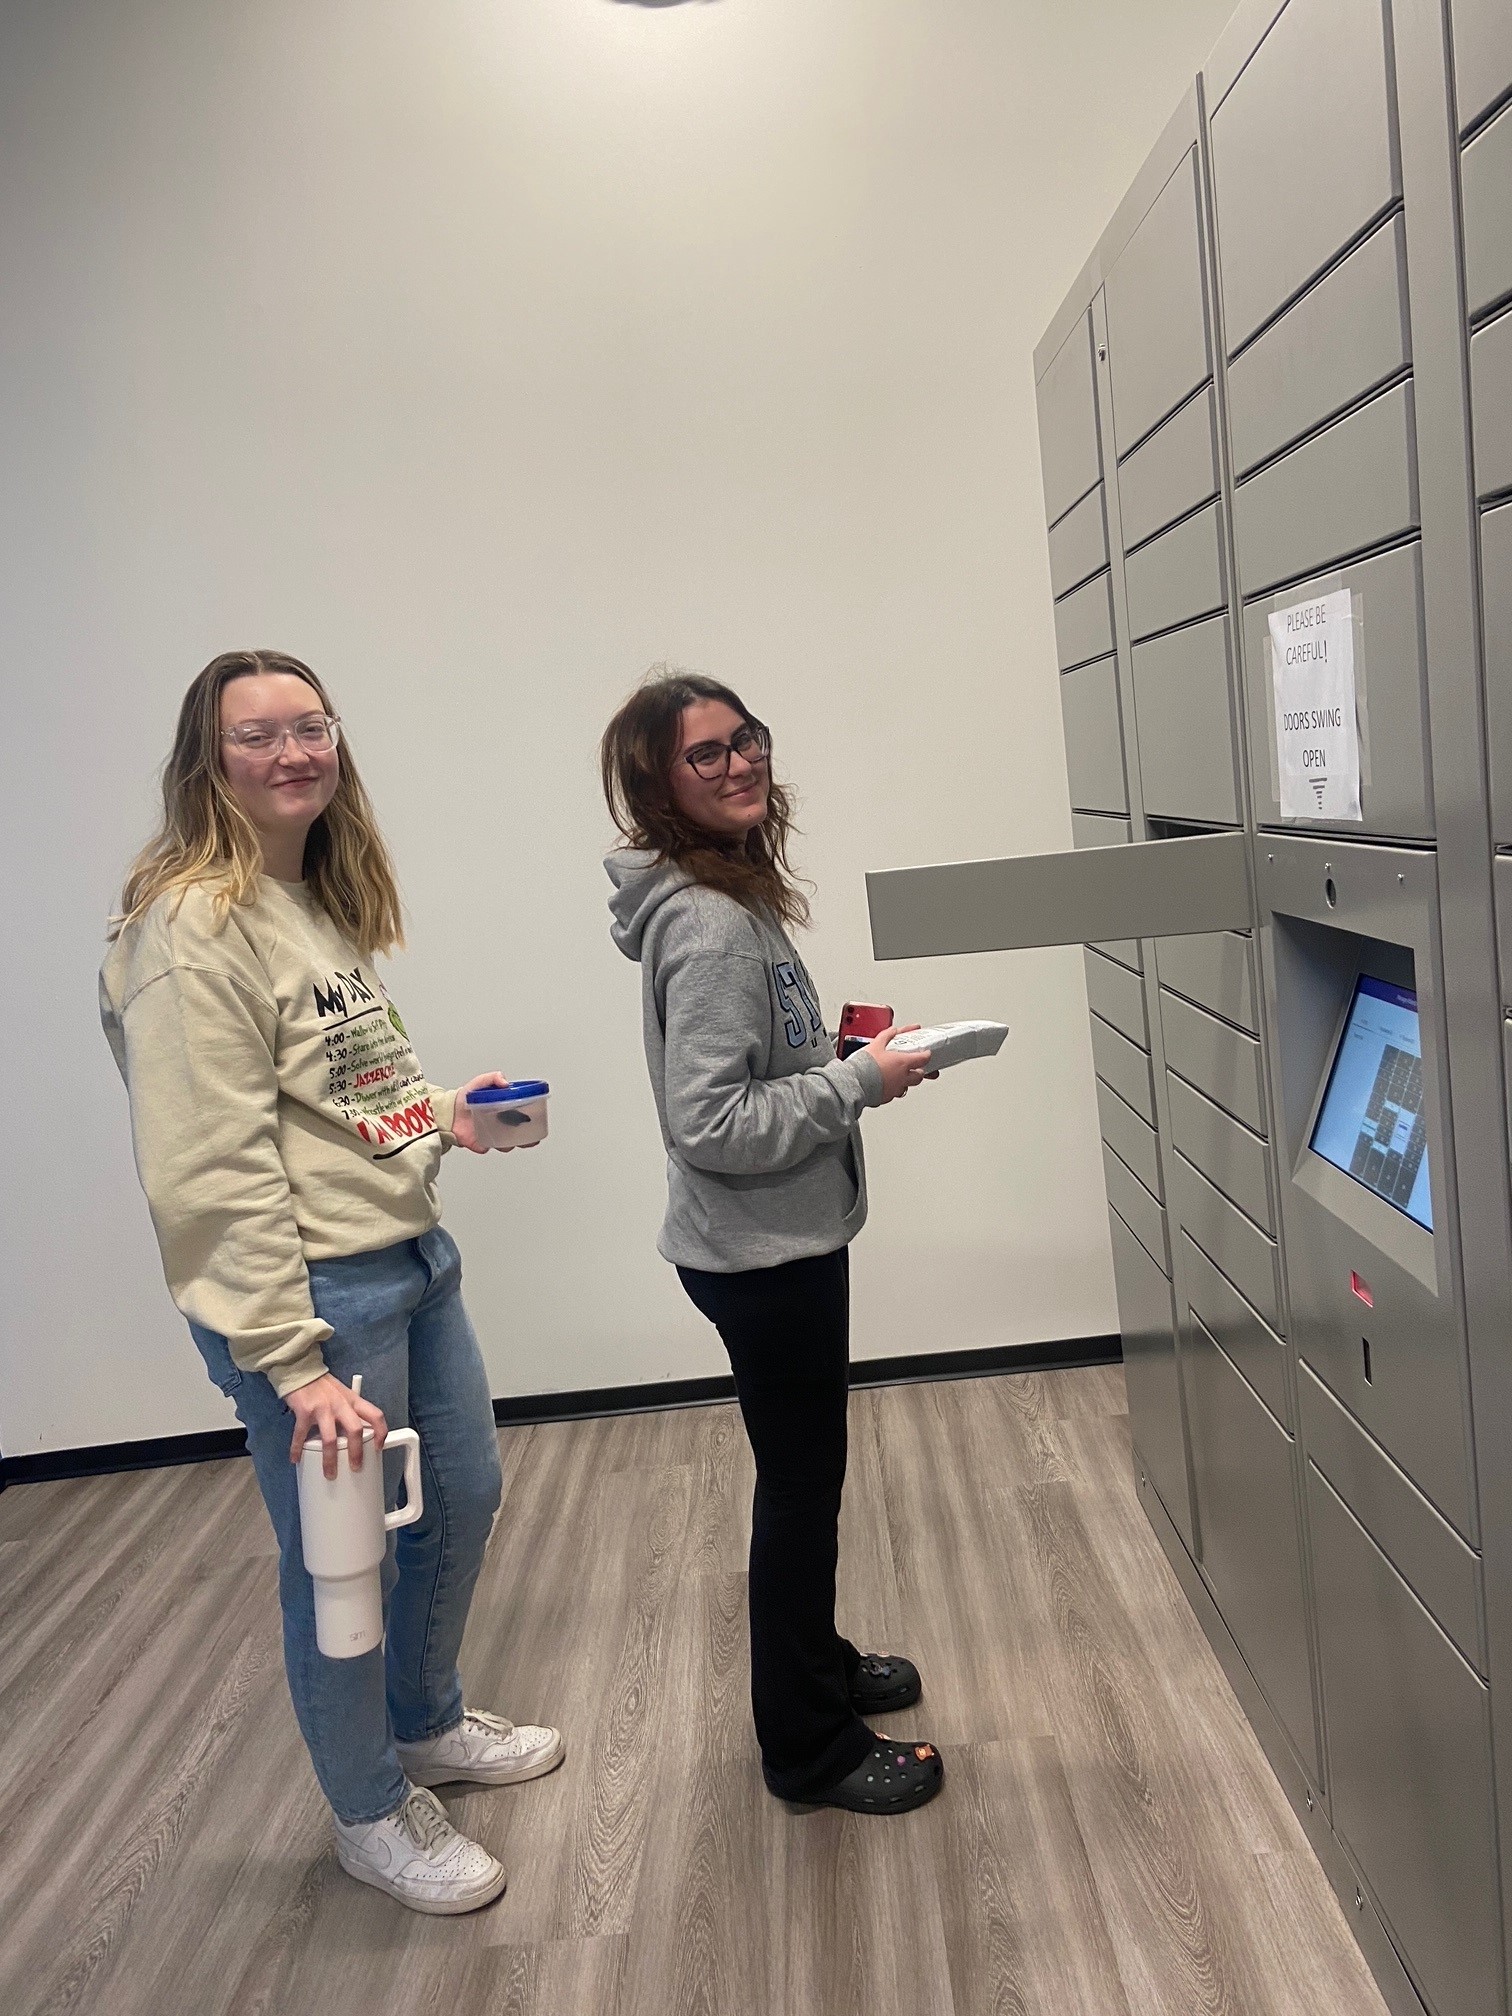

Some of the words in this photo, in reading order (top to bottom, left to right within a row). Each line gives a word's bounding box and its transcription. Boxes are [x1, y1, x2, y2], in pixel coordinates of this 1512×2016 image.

[1287, 607, 1314, 633] PLEASE
[1315, 604, 1326, 625] BE
[1286, 640, 1328, 665] CAREFUL!
[1283, 711, 1310, 731] DOORS
[1311, 708, 1341, 729] SWING
[1302, 749, 1326, 768] OPEN
[334, 966, 376, 1004] DAY
[324, 1032, 345, 1047] 4:00
[325, 1048, 347, 1062] 4:30
[329, 1064, 346, 1079] 5:00
[329, 1079, 347, 1095] 5:30
